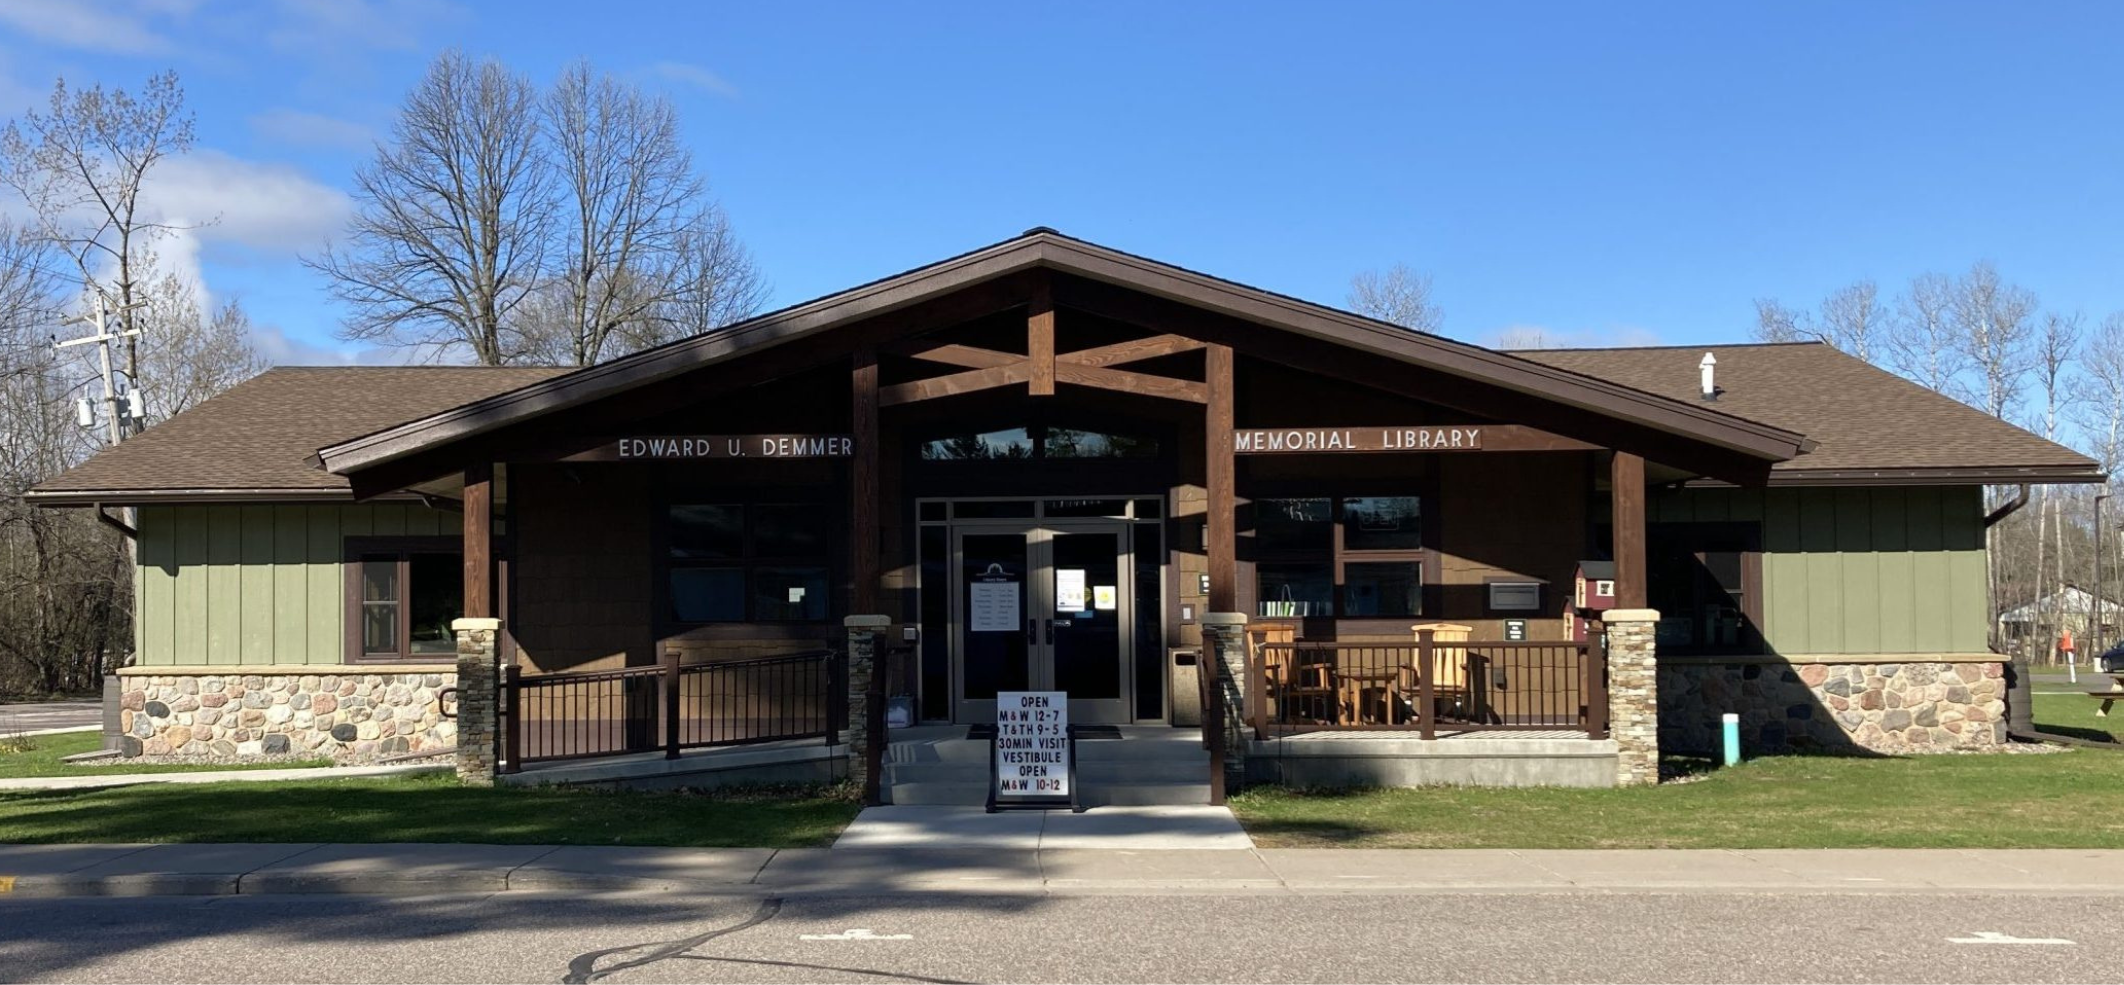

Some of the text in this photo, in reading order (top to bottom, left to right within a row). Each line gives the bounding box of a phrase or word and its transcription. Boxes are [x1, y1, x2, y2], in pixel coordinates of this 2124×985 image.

[1235, 429, 1480, 450] MEMORIAL LIBRARY
[619, 438, 852, 457] EDWARD U. DEMMER
[1021, 696, 1049, 708] OPEN
[999, 738, 1066, 749] 30MIN VISIT
[1003, 752, 1061, 763] VESTIBULE
[1019, 765, 1047, 777] OPEN
[1036, 779, 1060, 790] 10-12
